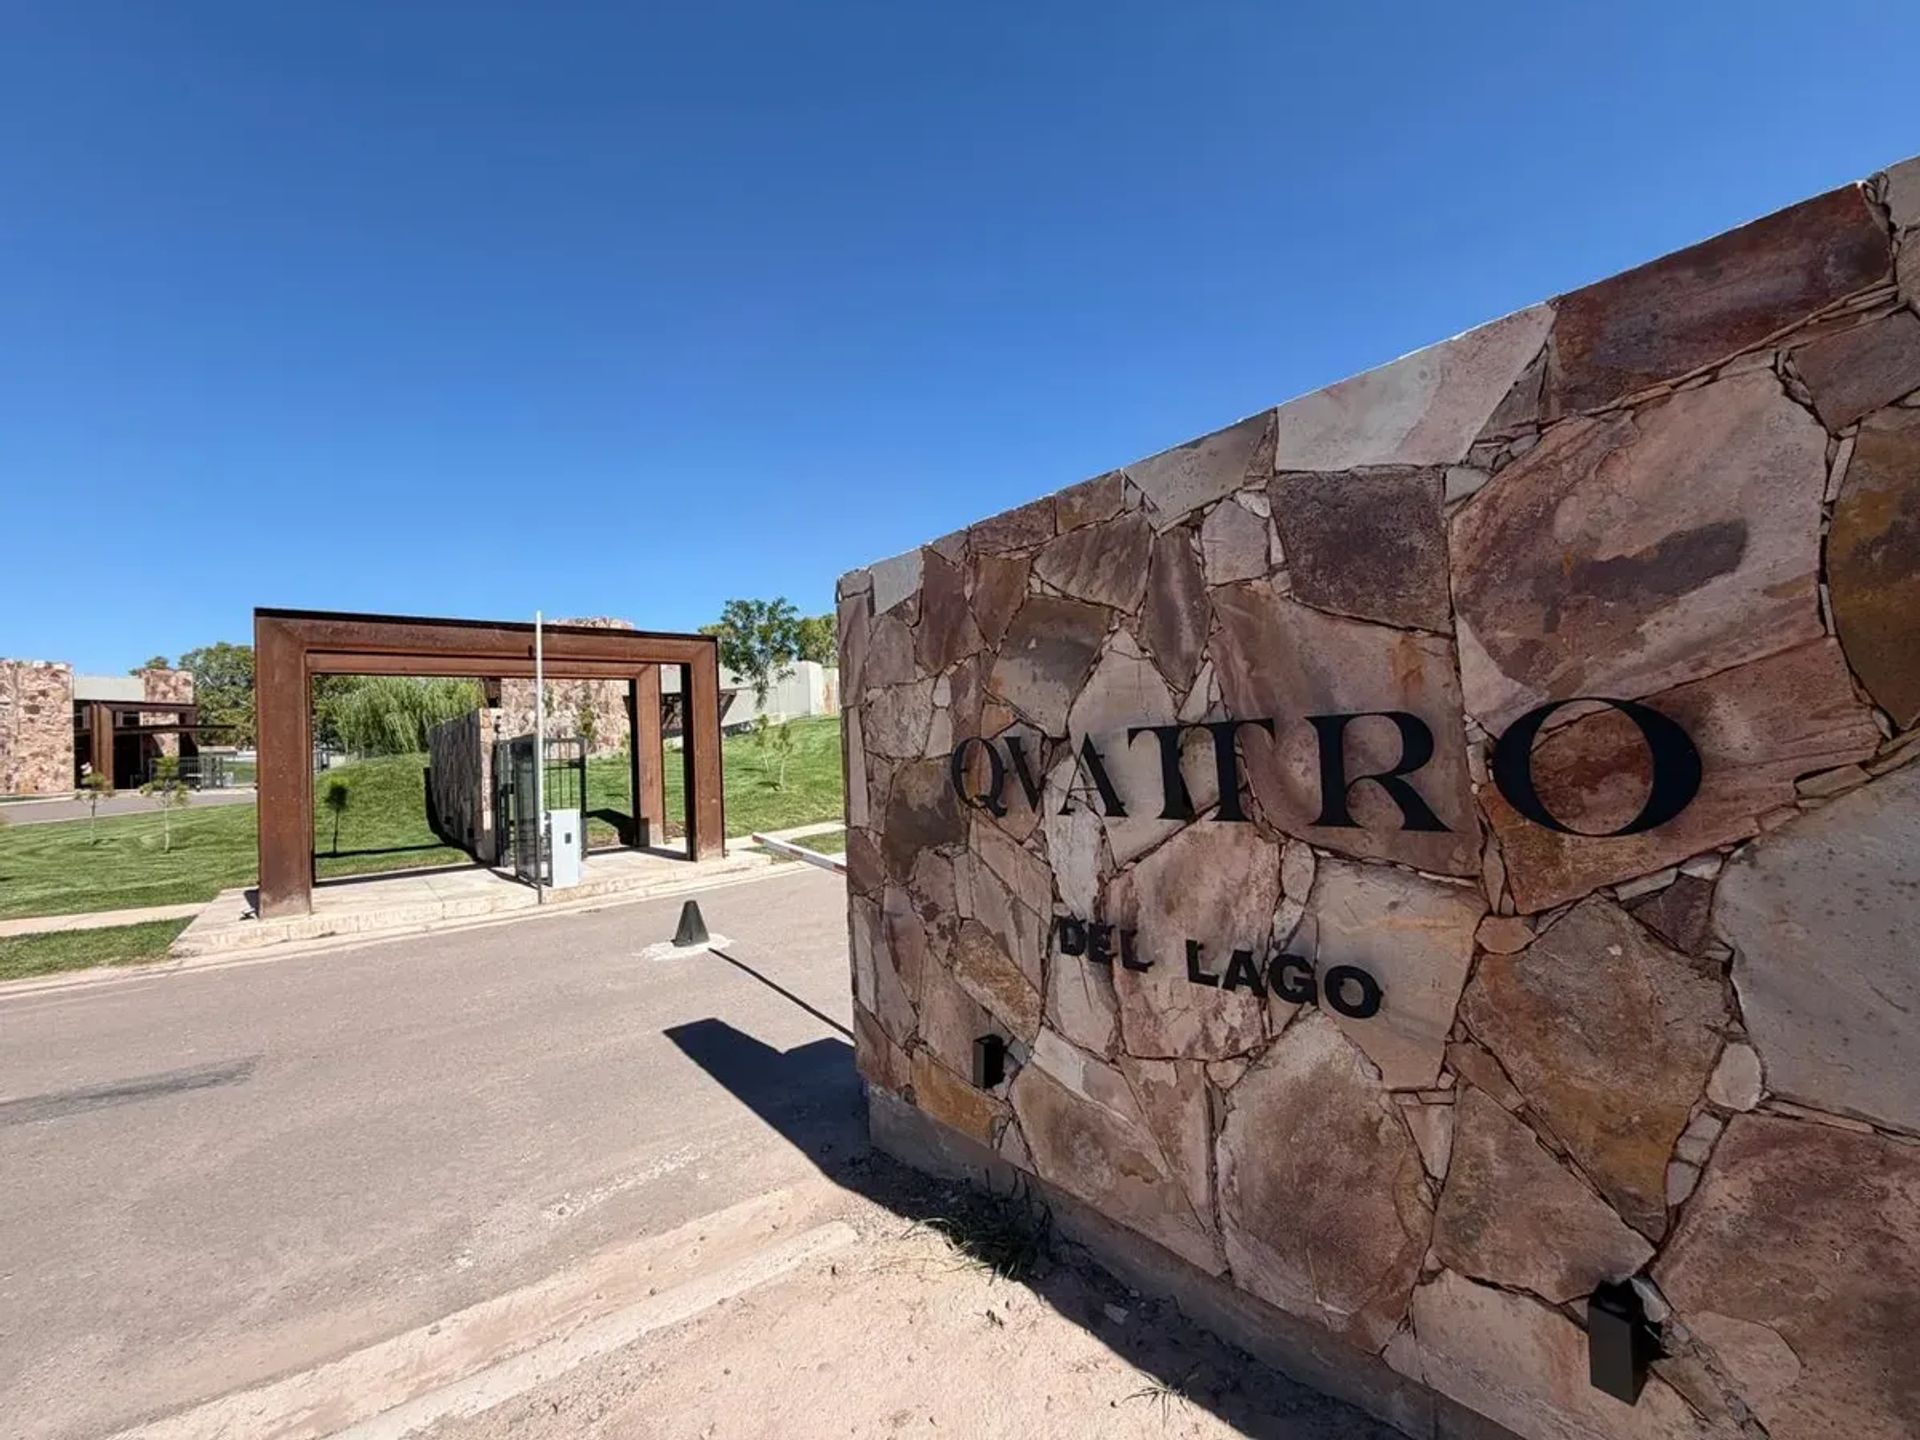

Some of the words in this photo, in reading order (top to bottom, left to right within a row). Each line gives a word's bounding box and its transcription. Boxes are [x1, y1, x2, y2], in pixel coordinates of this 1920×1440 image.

[951, 697, 1703, 837] QVATTRO
[1060, 917, 1154, 973] DEL
[1185, 940, 1382, 1019] LAGO
